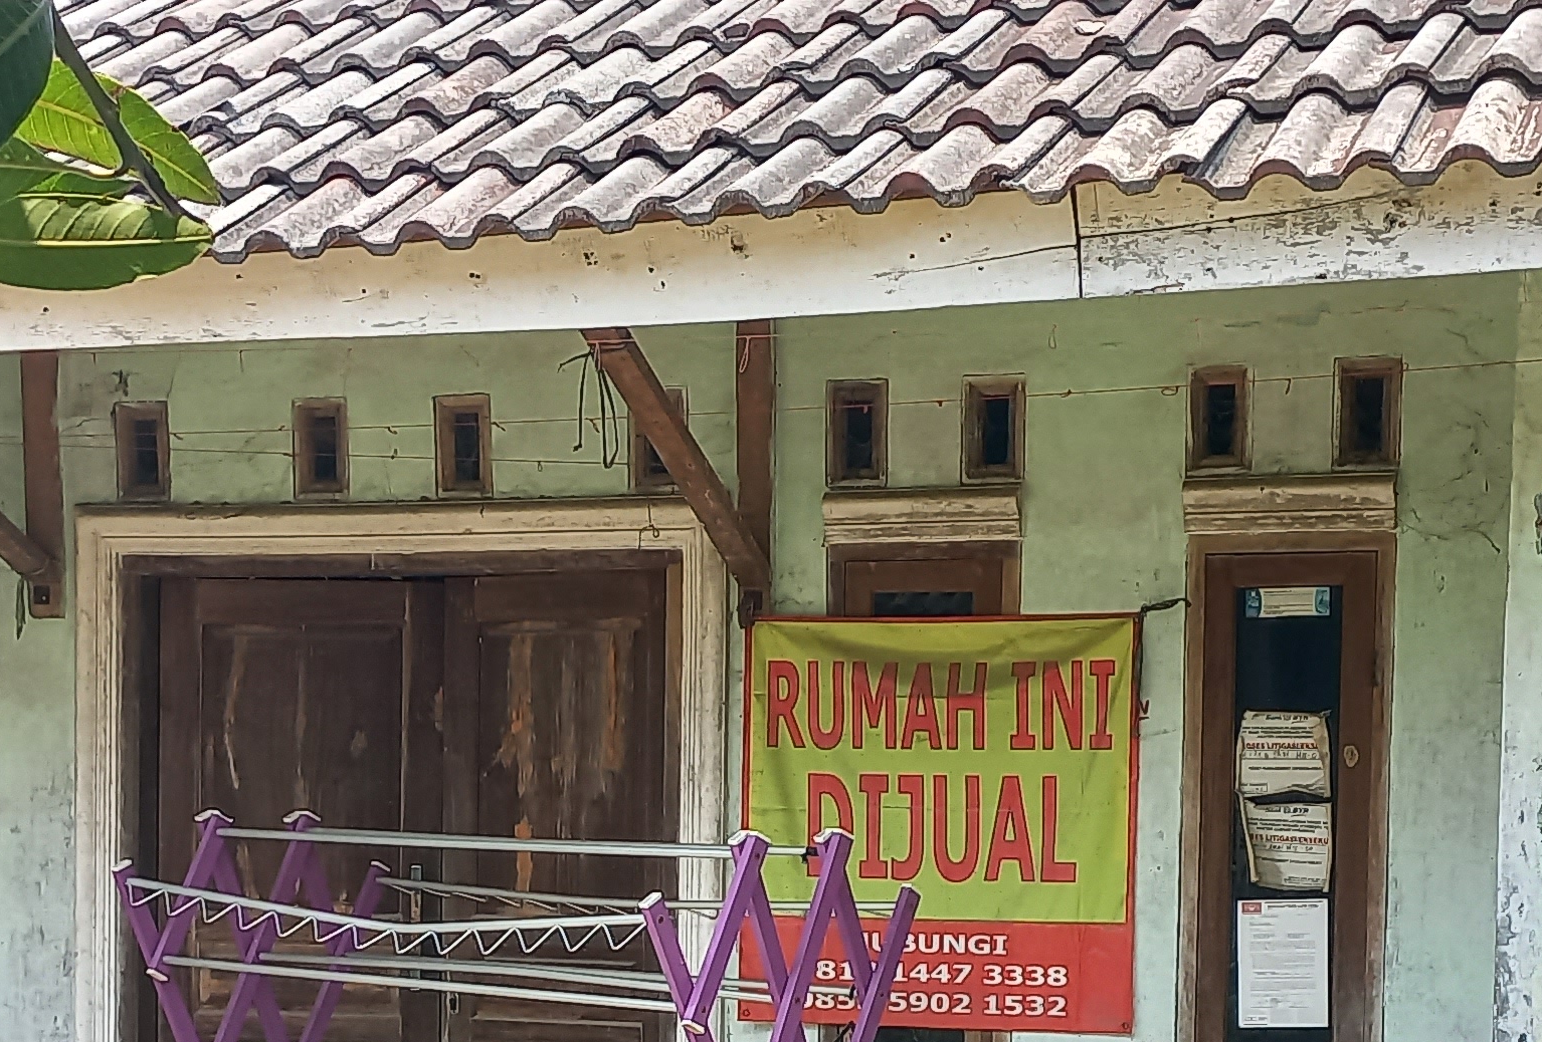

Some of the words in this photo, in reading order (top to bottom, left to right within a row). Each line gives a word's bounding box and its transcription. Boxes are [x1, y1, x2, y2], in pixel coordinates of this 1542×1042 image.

[766, 660, 989, 751] RUMAH
[1009, 659, 1116, 751] INI
[806, 773, 1078, 883] DIJUAL
[863, 932, 1008, 956] UBUNGI
[815, 960, 877, 981] 81
[892, 962, 972, 984] 1447
[982, 964, 1069, 987] 3338
[887, 991, 972, 1015] 5902
[982, 994, 1068, 1017] 1532
